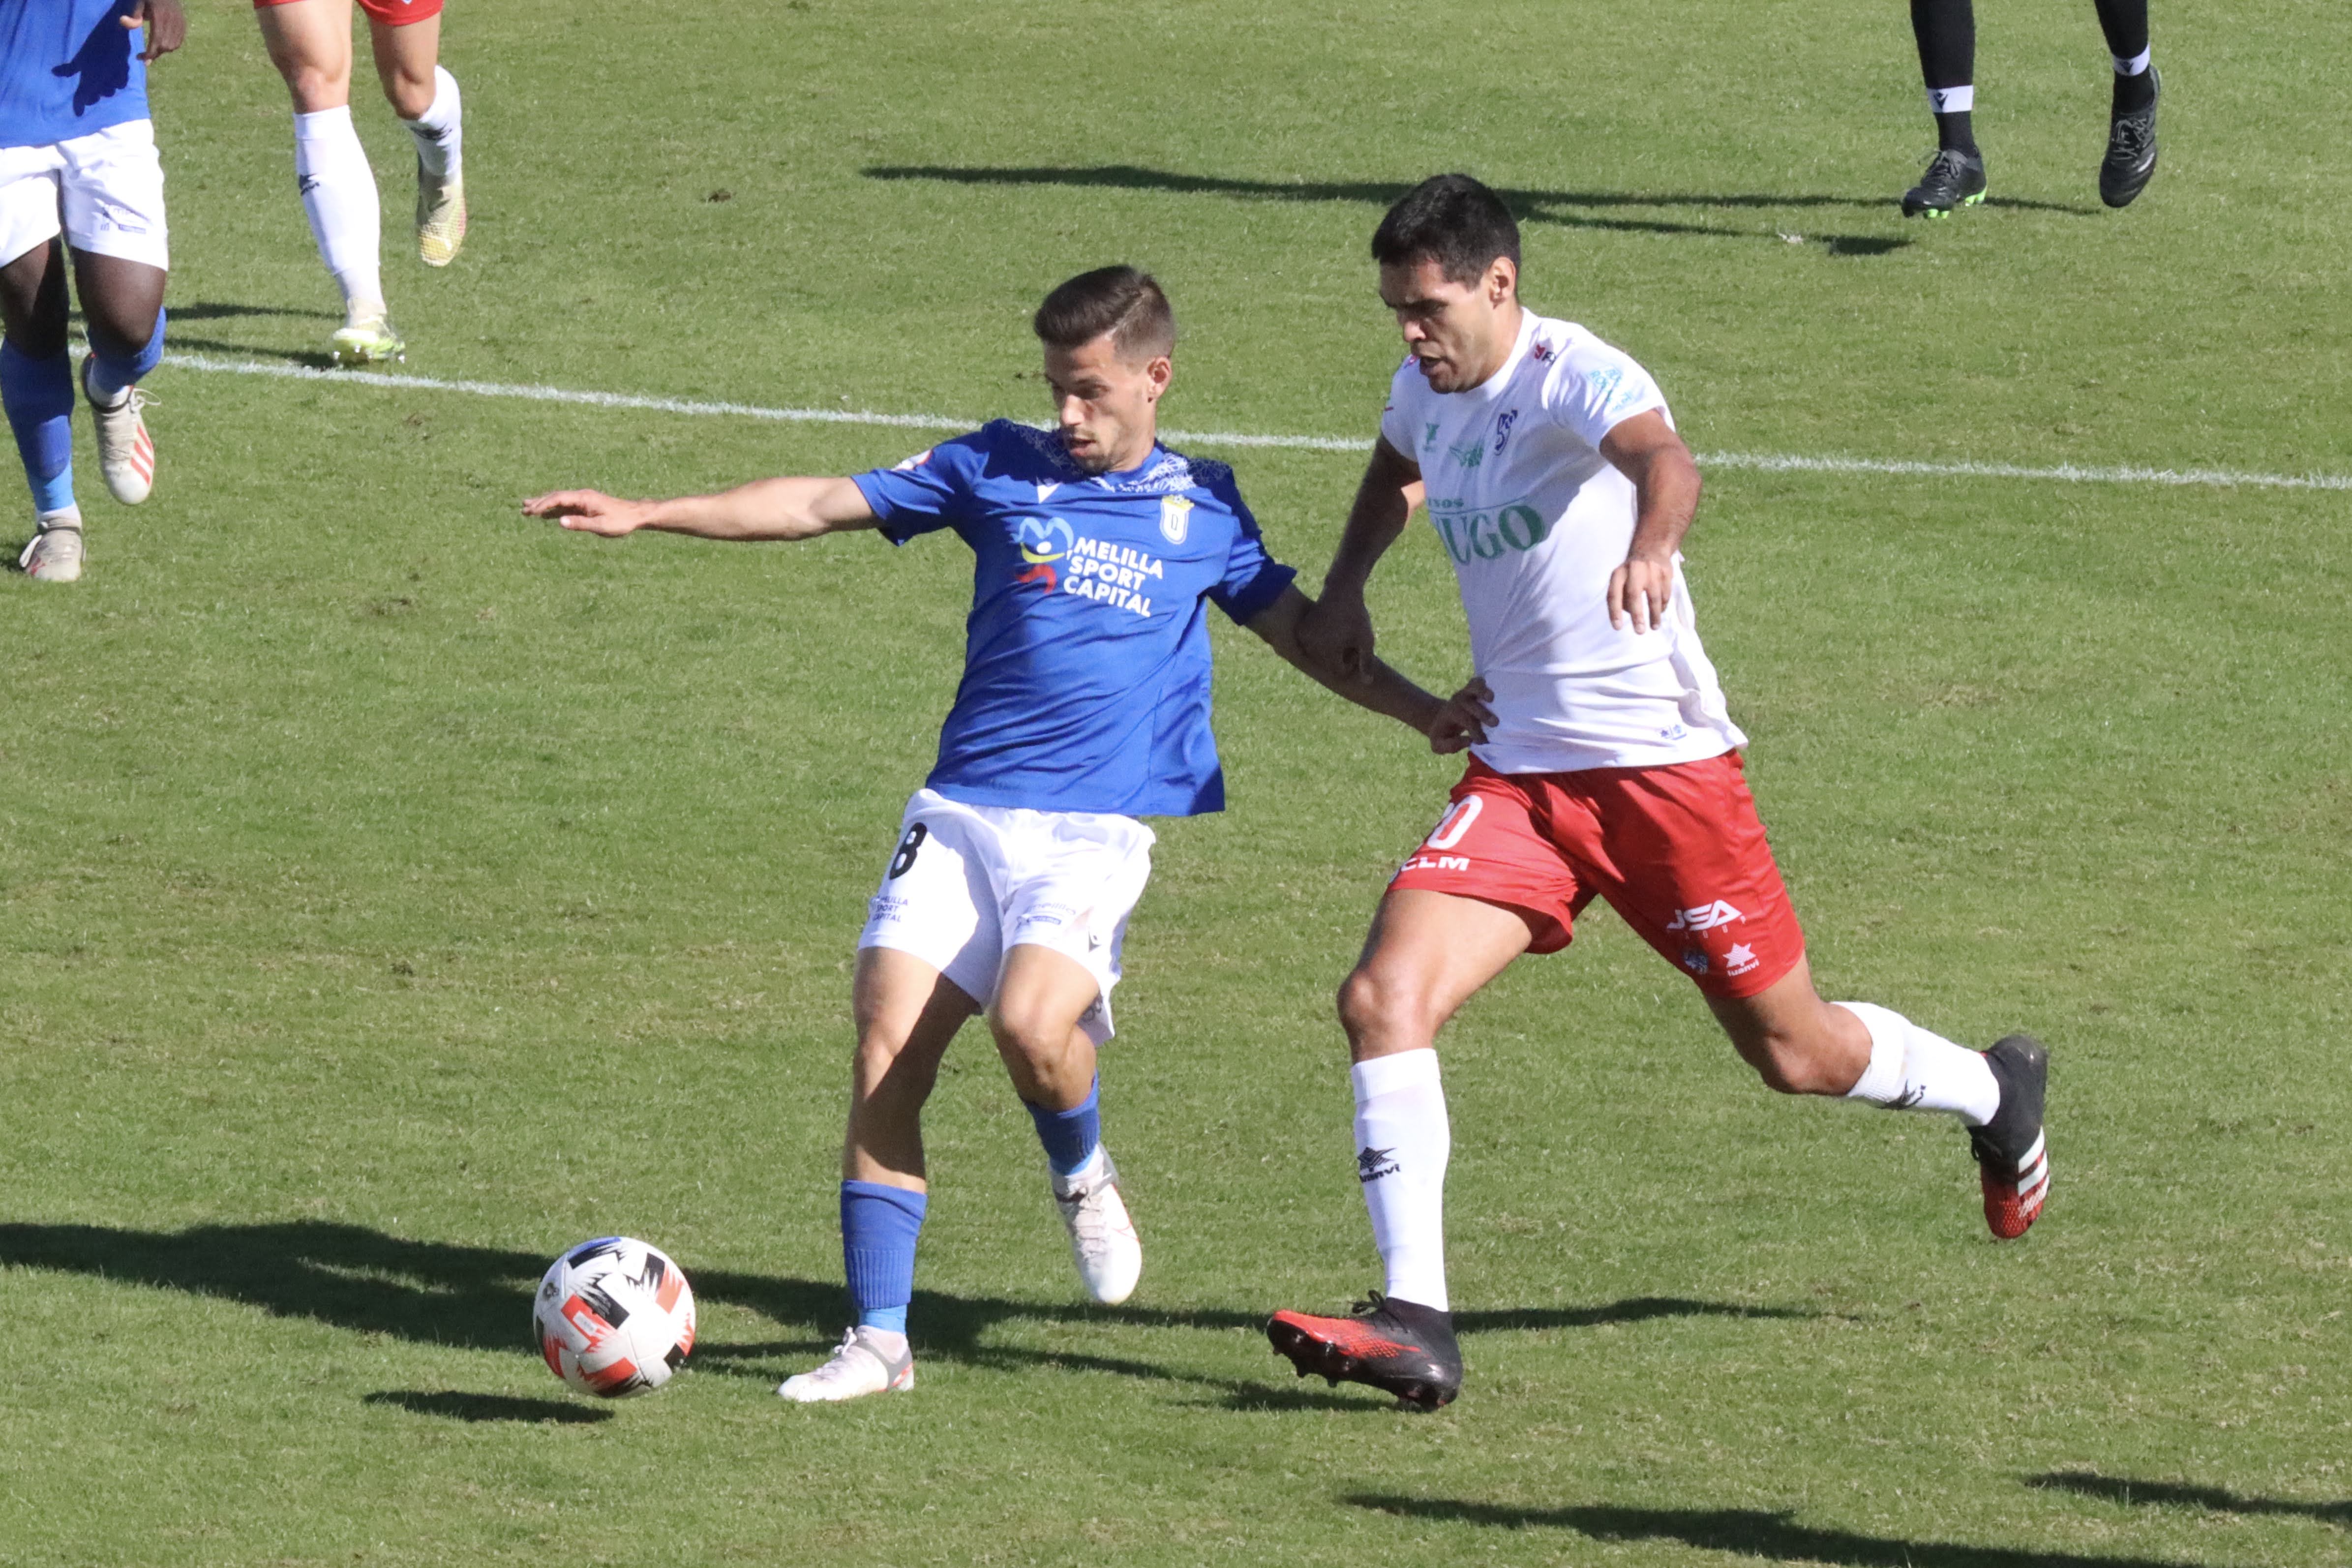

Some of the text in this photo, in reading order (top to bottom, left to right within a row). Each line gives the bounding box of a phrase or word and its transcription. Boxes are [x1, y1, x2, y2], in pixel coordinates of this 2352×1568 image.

[1436, 505, 1545, 564] UGO
[1068, 555, 1146, 591] SPORT
[1074, 537, 1163, 579] MELILLA
[1063, 575, 1151, 617] CAPITAL
[889, 822, 928, 880] 8
[1401, 856, 1470, 872] CLM
[1667, 900, 1742, 931] JSA
[1727, 958, 1760, 977] luanvi
[1359, 1164, 1400, 1183] uanvi
